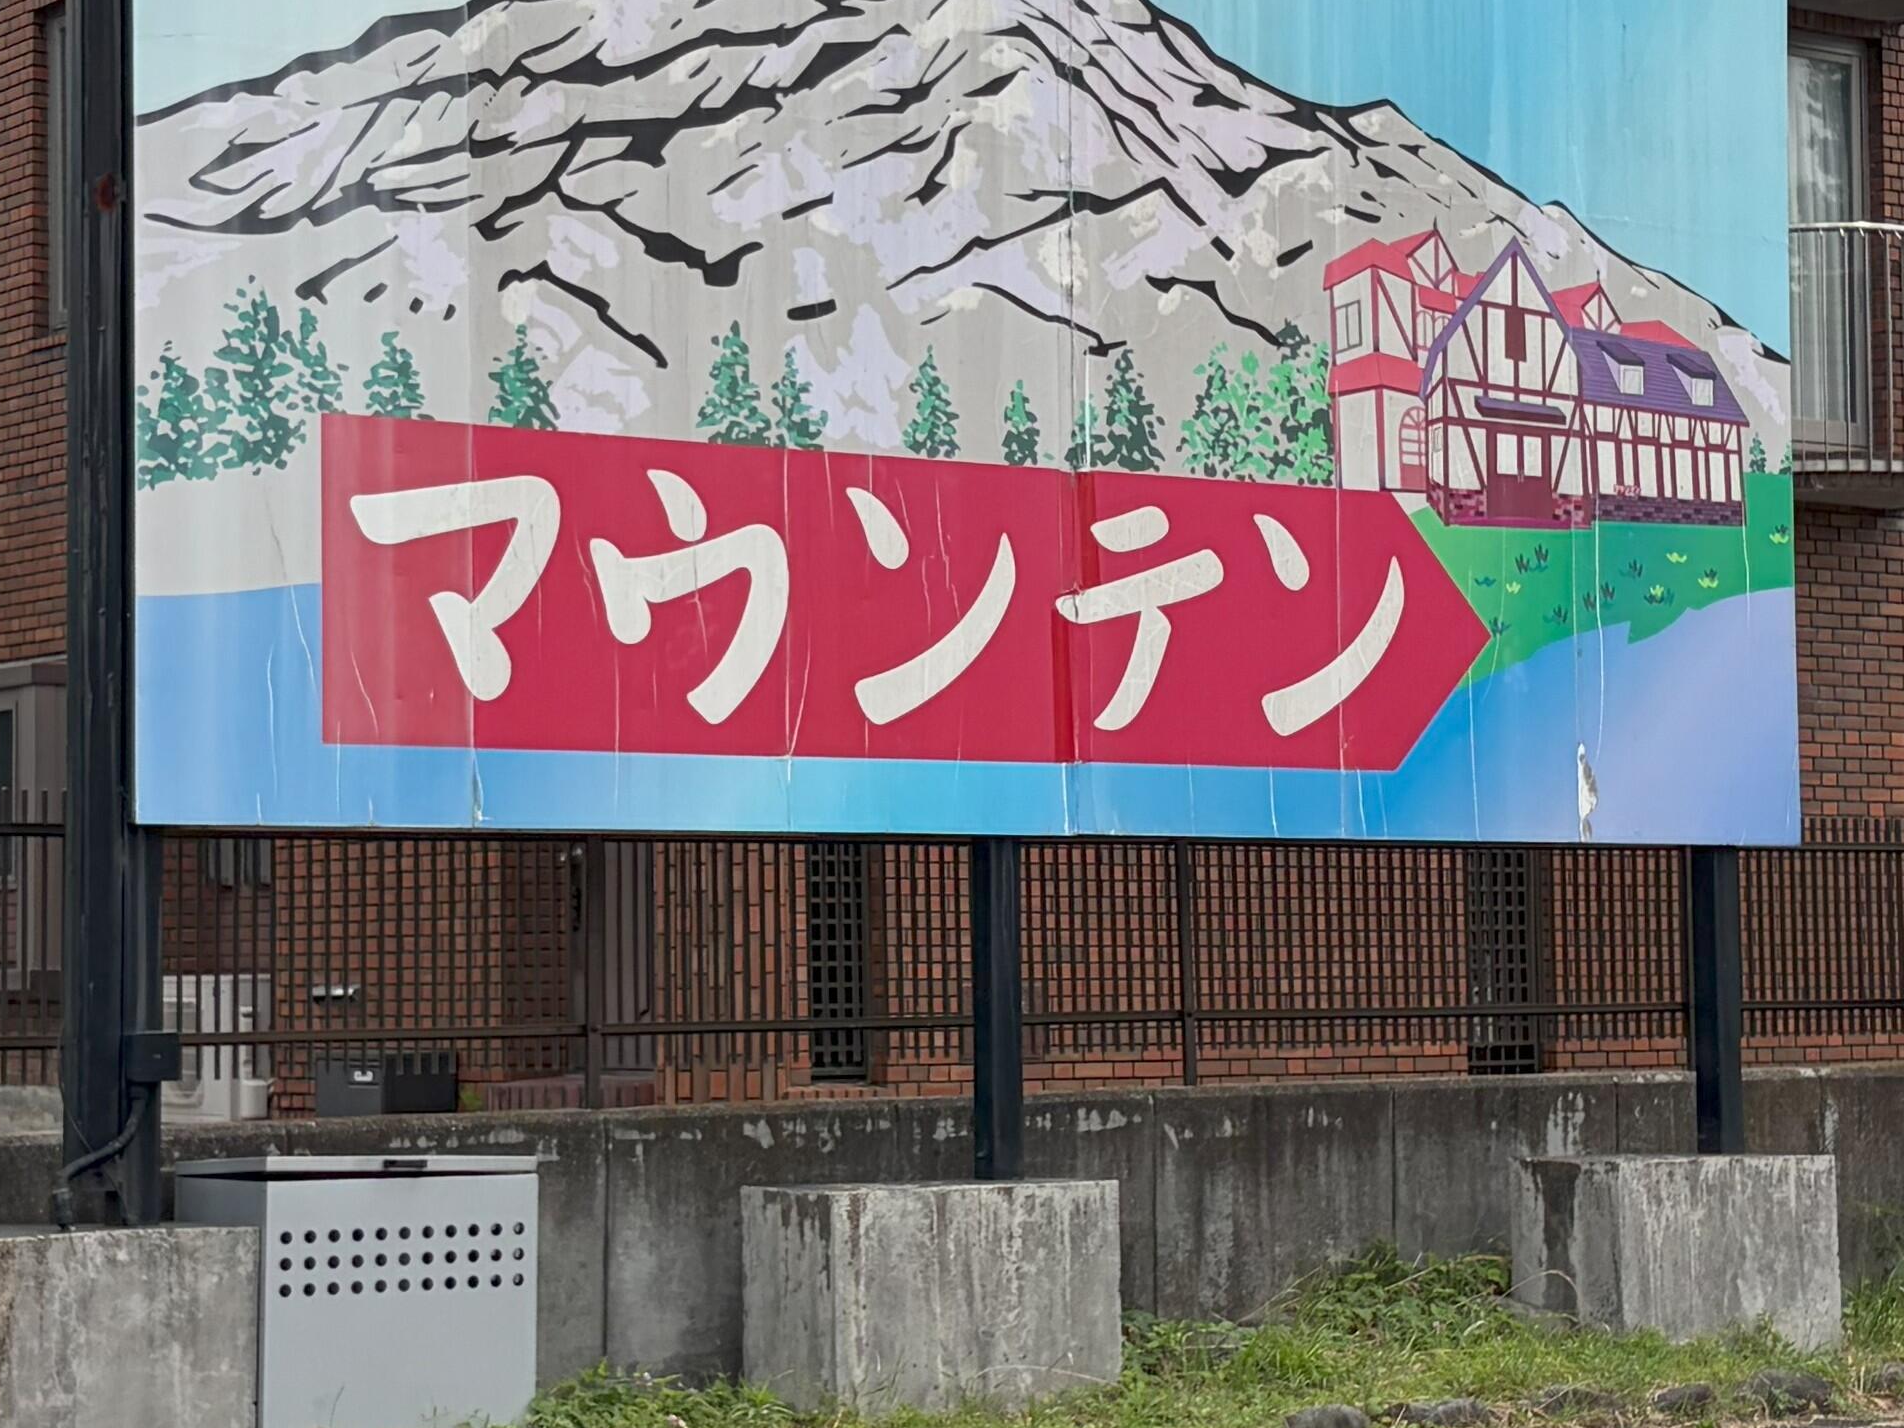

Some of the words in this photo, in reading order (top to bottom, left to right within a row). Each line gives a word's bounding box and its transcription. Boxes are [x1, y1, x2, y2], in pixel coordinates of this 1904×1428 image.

[349, 467, 1406, 736] マウンテン
